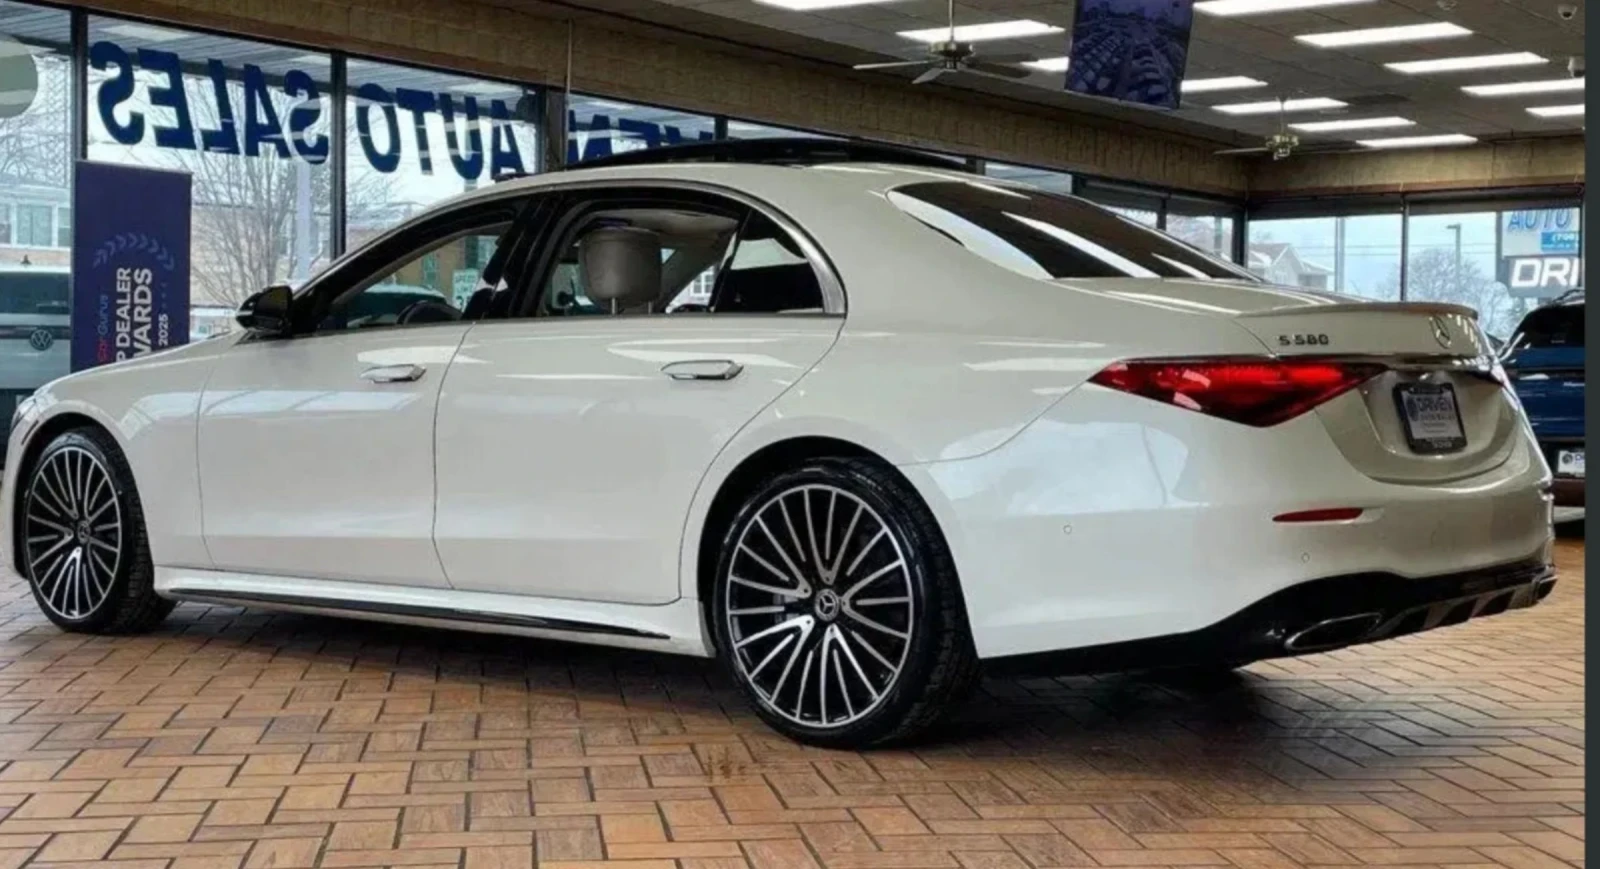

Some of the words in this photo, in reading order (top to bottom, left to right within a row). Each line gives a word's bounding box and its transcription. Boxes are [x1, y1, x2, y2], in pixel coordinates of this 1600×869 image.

[116, 267, 131, 348] DEALER
[158, 313, 169, 345] 2025
[1279, 334, 1290, 346] S
[1294, 333, 1329, 346] 580
